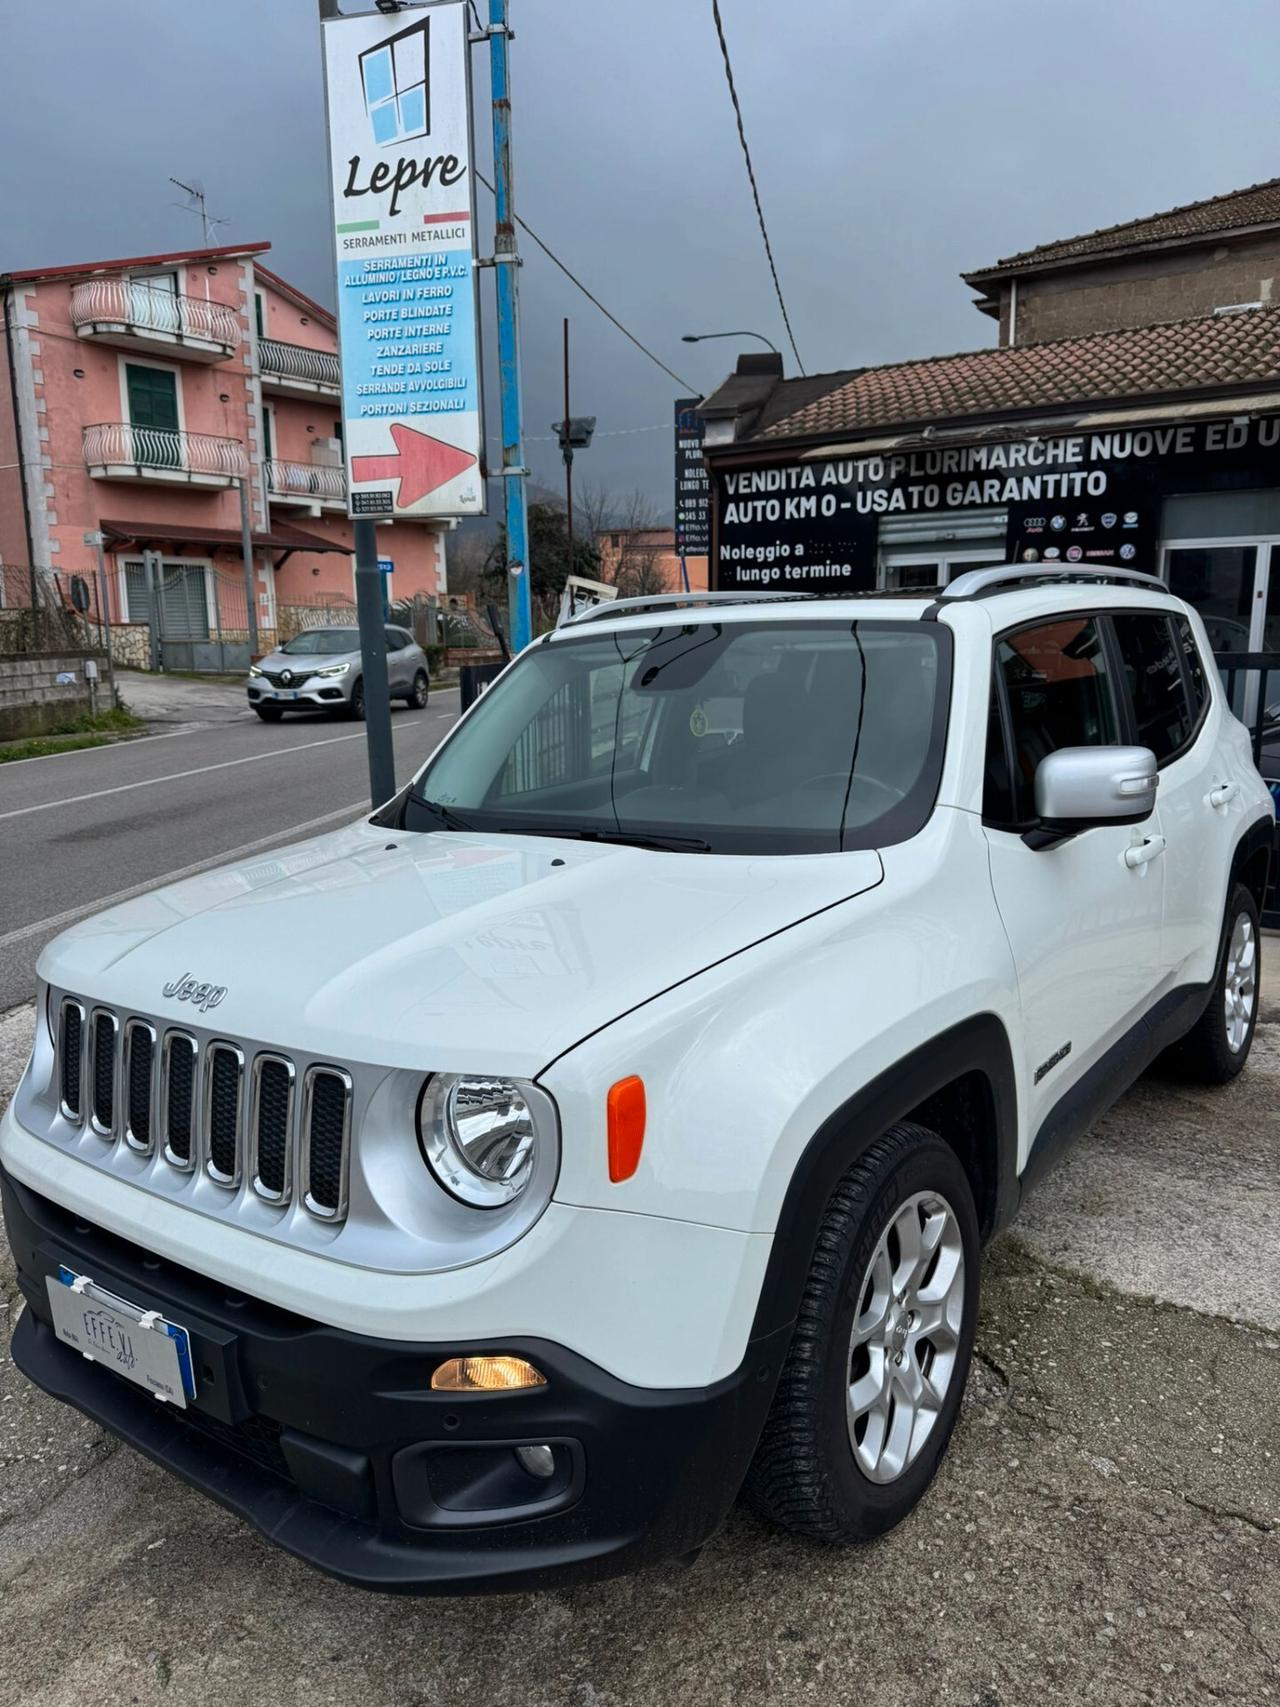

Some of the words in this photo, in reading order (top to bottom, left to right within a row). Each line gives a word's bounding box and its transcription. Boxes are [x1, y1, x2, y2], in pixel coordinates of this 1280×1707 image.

[343, 154, 467, 216] Lepre
[343, 233, 407, 249] SERRAMENTI
[412, 228, 465, 242] METALLICI
[363, 257, 432, 273] SERRAMENTI
[434, 254, 447, 265] IN
[442, 267, 468, 278] P.V.C.
[362, 290, 399, 304] LAVORI
[402, 289, 415, 300] IN
[417, 286, 452, 299] FERRO
[363, 309, 398, 323] PORTE
[401, 306, 453, 319] BLINDATE
[368, 328, 402, 341] PORTE
[404, 324, 451, 338] INTERNE
[376, 343, 443, 359] ZANZARIERE
[370, 364, 404, 377] TENDE
[407, 363, 421, 374] DA
[425, 361, 451, 373] SOLE
[356, 383, 406, 396] SERRANDE
[409, 378, 467, 392] AVVOLGIBILI
[360, 403, 407, 416] PORTONI
[410, 399, 465, 412] SEZIONALI
[724, 466, 816, 496] VENDITA
[821, 457, 884, 486] AUTO
[890, 436, 1084, 479] PLURIMARCHE
[1090, 427, 1196, 461] NUOVE
[1205, 423, 1248, 451] ED
[1258, 418, 1280, 447] U
[724, 498, 780, 524] AUTO
[856, 483, 940, 514] USATO
[946, 470, 1108, 506] GARANTITO
[720, 540, 790, 561] Noleggio
[794, 543, 804, 556] a
[736, 565, 780, 584] lungo
[784, 560, 852, 579] termine
[162, 972, 228, 1013] Jeep
